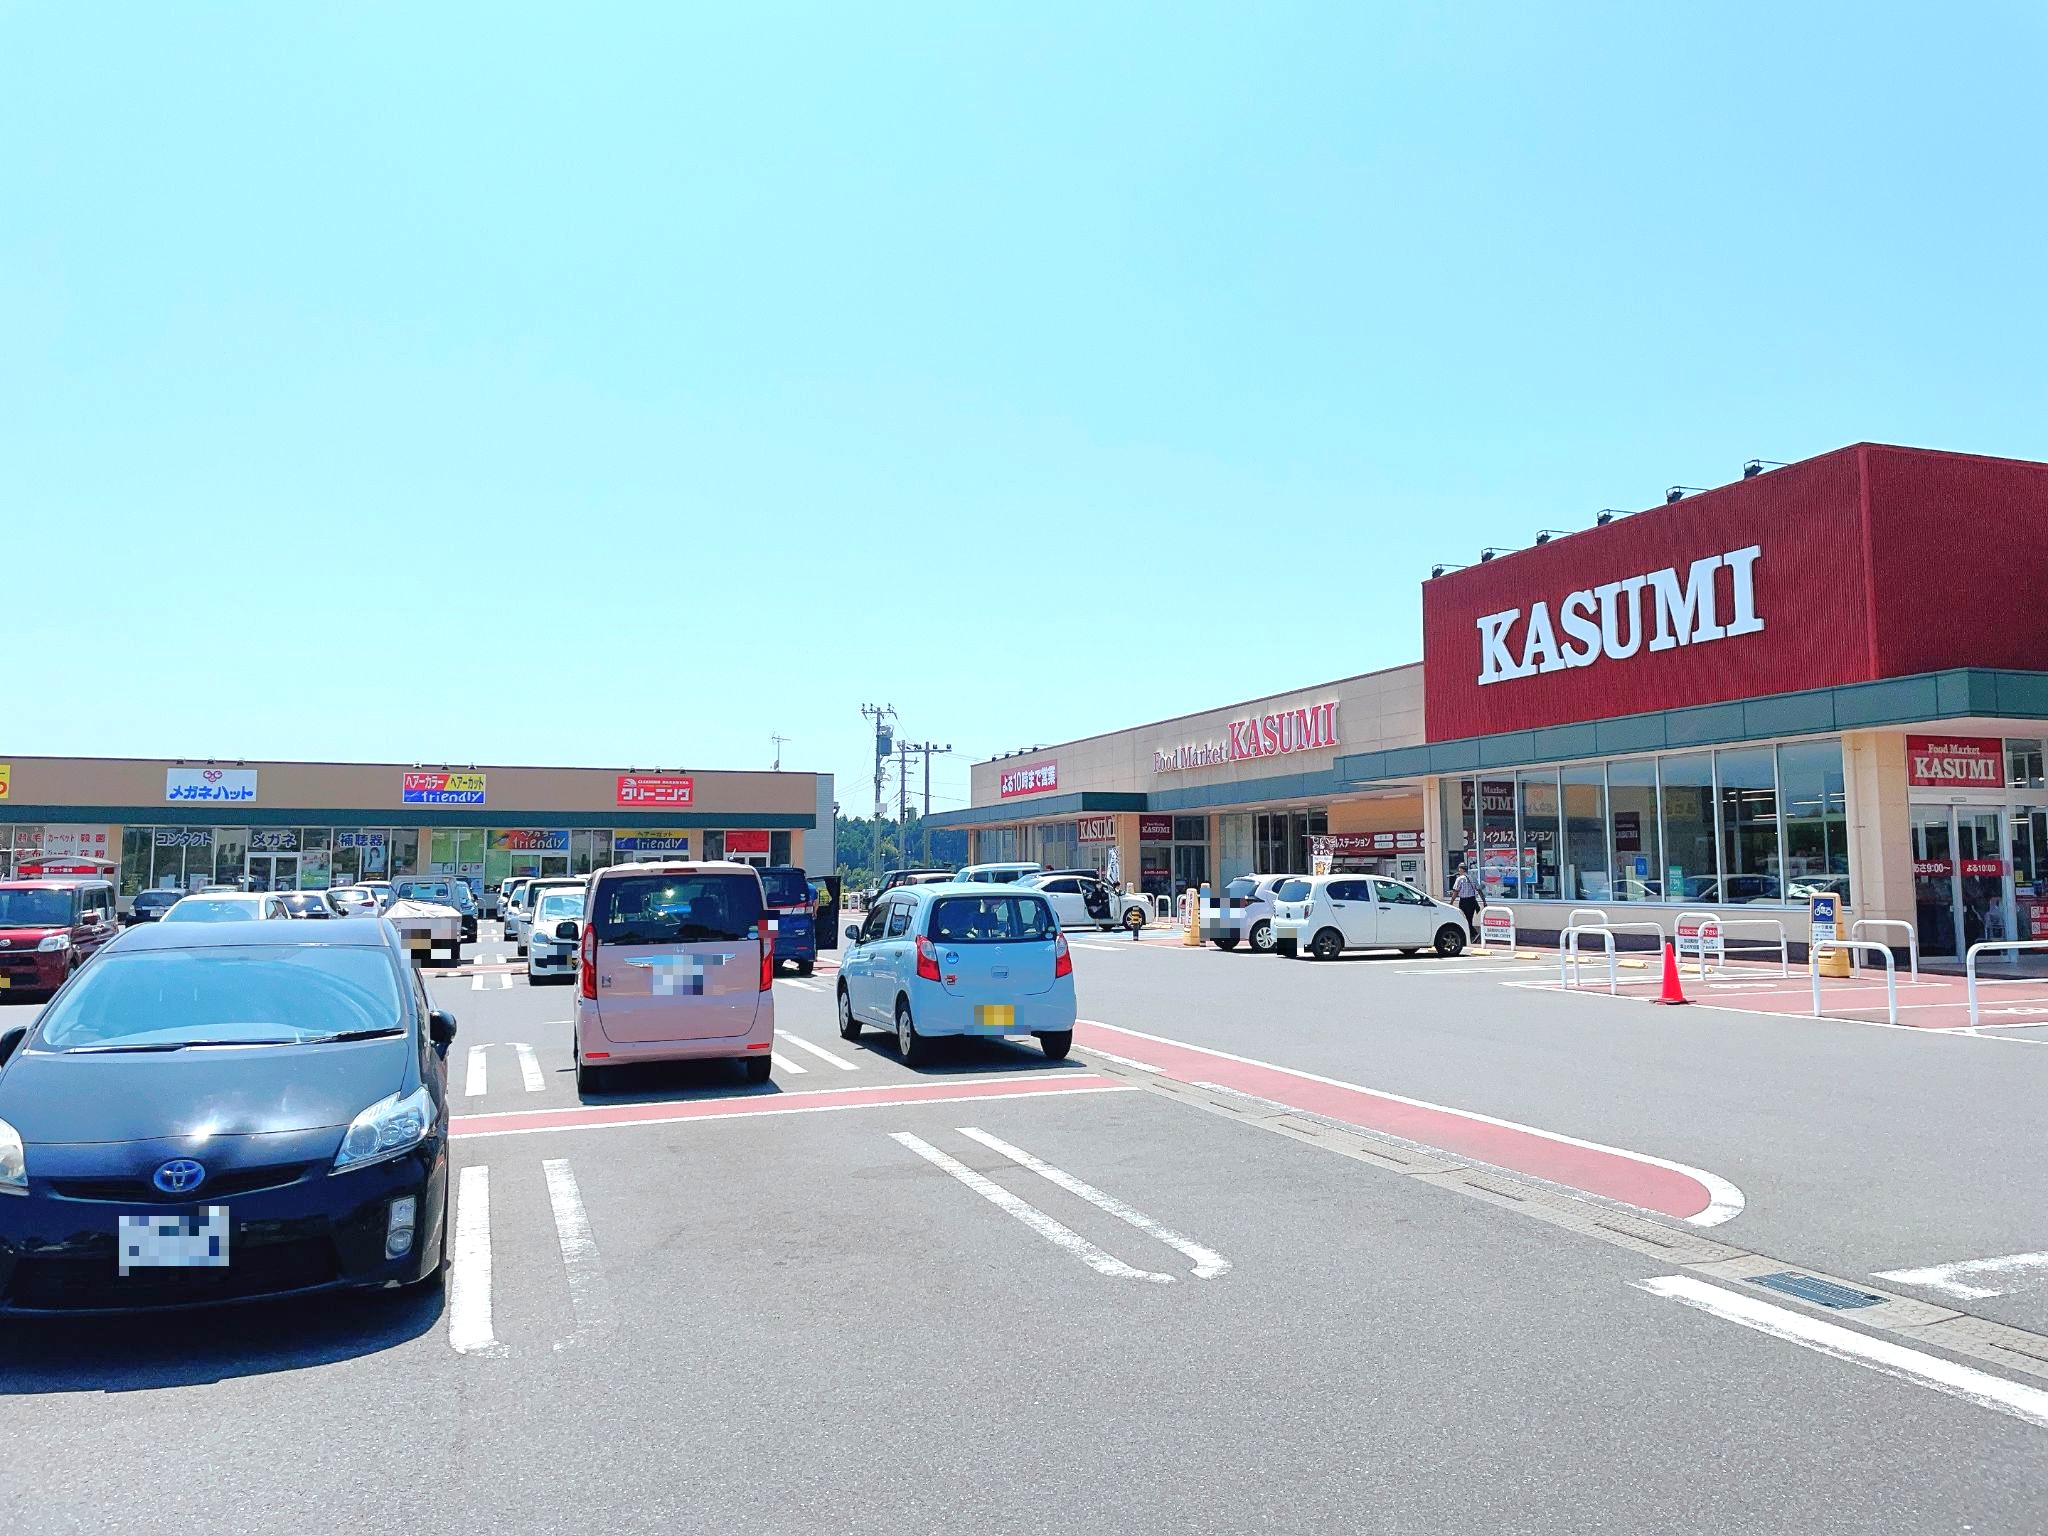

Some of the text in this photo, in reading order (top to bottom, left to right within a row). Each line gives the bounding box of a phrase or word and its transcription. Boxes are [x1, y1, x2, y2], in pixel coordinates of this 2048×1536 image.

[1476, 545, 1764, 685] KASUMI
[1152, 702, 1339, 774] Food Market KASUMI
[1928, 744, 1980, 754] Food Market
[1914, 757, 1995, 779] KASUMI
[406, 775, 484, 790] ヘアーカラー ヘアーカット
[1002, 765, 1056, 793] よる10時まで営業
[169, 785, 253, 800] メガネハット
[421, 792, 482, 803] friendly
[621, 788, 690, 801] クリーニング
[1079, 818, 1116, 839] KASUMI
[156, 833, 212, 847] コンタクト
[252, 833, 297, 847] メガネ
[339, 833, 384, 847] 補聴器
[513, 837, 566, 849] friendly
[637, 838, 682, 850] friendly
